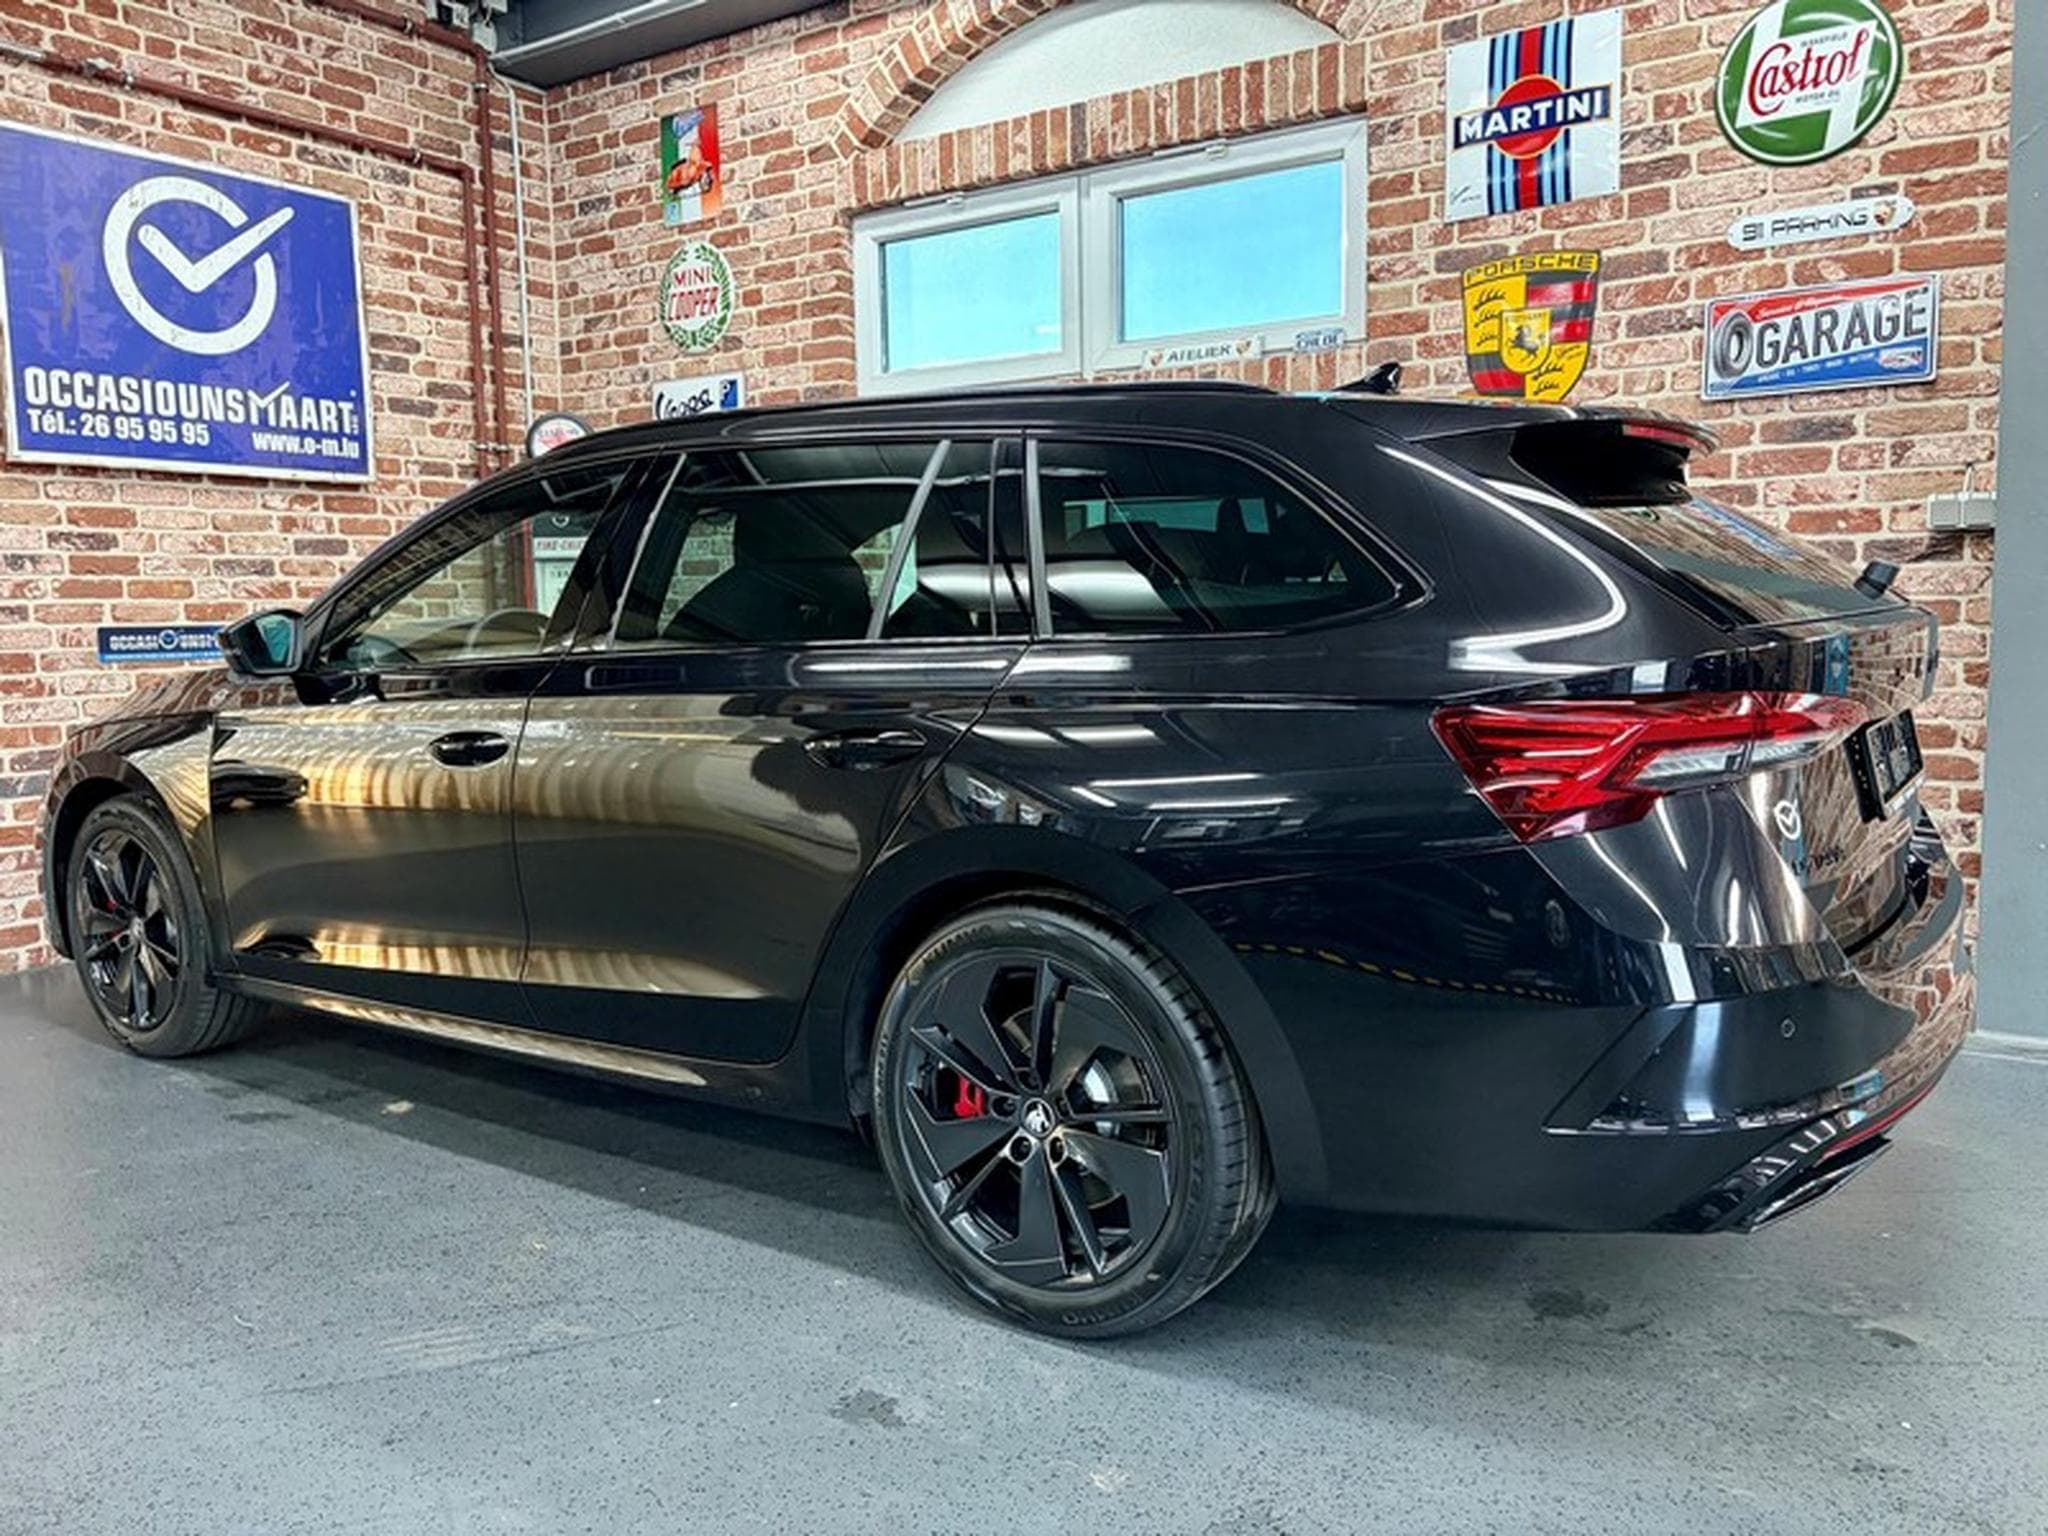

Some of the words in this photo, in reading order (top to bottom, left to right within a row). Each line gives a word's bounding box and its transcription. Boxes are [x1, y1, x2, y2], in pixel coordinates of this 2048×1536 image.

[1747, 28, 1870, 117] Castrol
[1460, 90, 1603, 144] MARTINI
[1771, 209, 1869, 238] PARKING
[674, 265, 711, 288] MINI
[1465, 255, 1594, 285] PORSCHE
[667, 286, 719, 321] COOPER
[80, 412, 110, 439] 26
[115, 415, 145, 441] 95
[148, 418, 178, 444] 95
[181, 422, 211, 447] 95
[252, 430, 360, 459] www.o-m.lu
